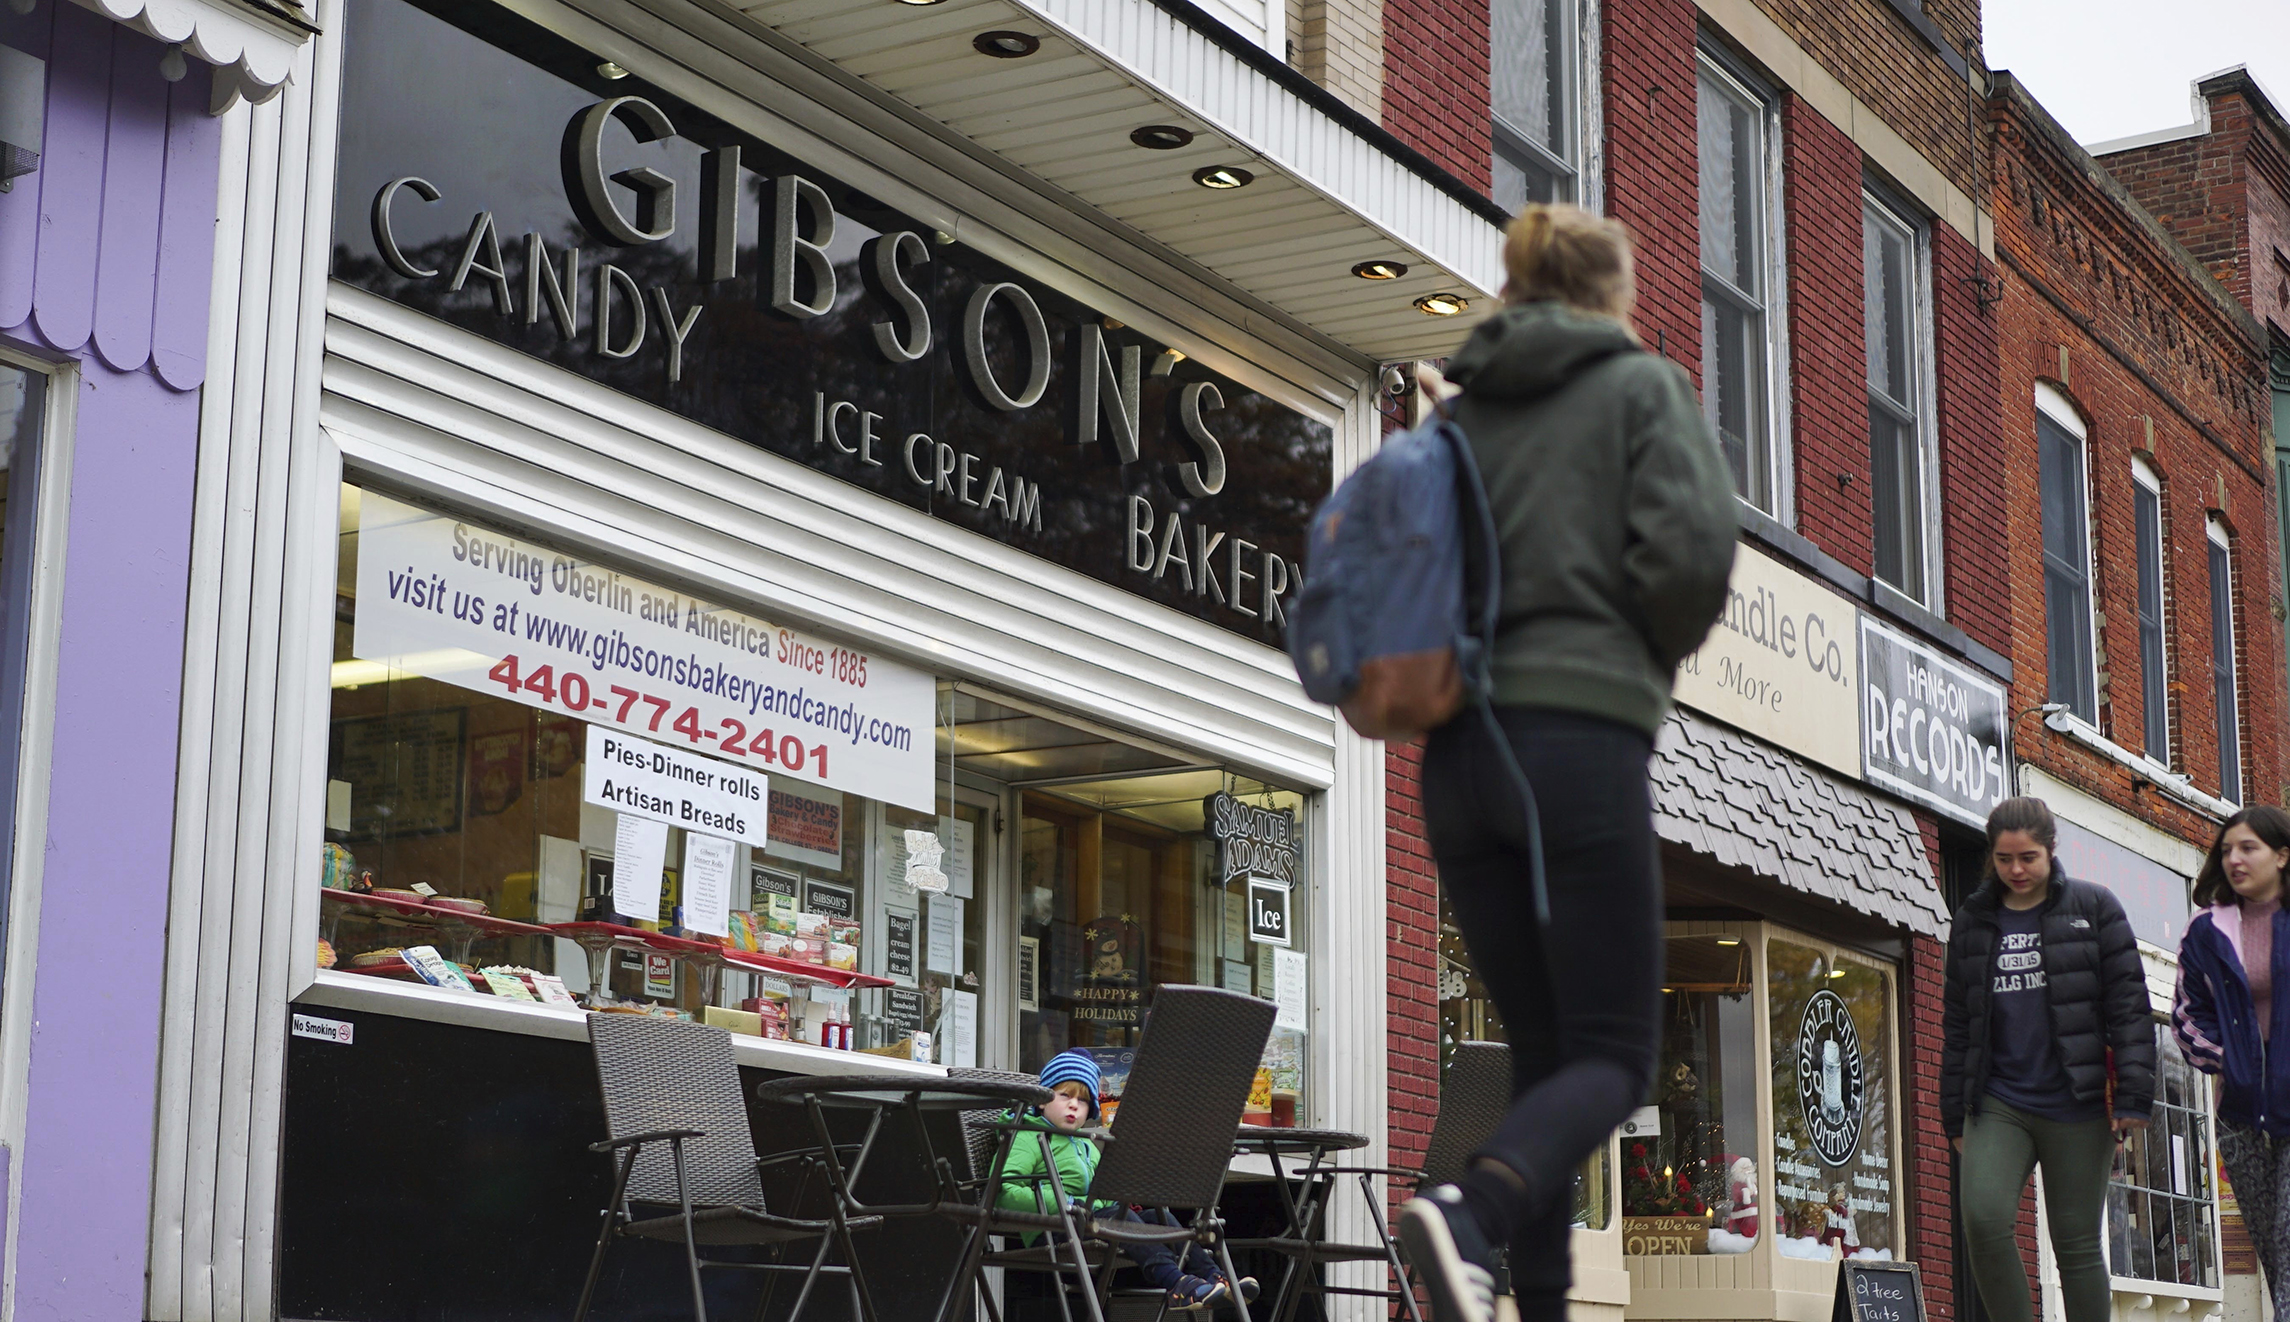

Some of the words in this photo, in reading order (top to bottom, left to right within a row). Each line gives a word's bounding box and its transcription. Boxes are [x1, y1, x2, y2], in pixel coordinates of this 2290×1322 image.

[371, 176, 703, 382] CANDY
[561, 96, 1226, 497] GIBSON'S
[815, 392, 883, 466] ICE
[904, 434, 1042, 532] CREAM
[452, 522, 544, 596] Serving
[552, 555, 632, 614] Oberlin
[640, 589, 679, 630] and
[685, 600, 771, 659] America
[777, 629, 824, 675] Since
[829, 646, 867, 688] 1885
[1716, 585, 1796, 659] ndle
[1805, 612, 1847, 687] Co.
[388, 566, 447, 615] visit
[453, 591, 485, 632] us
[493, 600, 519, 635] at
[526, 613, 911, 752] www.gibsonsbakeryandcandy.com
[1717, 656, 1782, 712] More
[1906, 660, 1969, 724] HANSON
[488, 654, 829, 779] 440-774-2401
[1869, 683, 2001, 807] RECORDS
[602, 739, 715, 788] Pies-Dinner
[719, 774, 761, 801] rolls
[601, 779, 674, 817] Artisan
[681, 799, 746, 835] Breads
[769, 790, 839, 819] GIBSON'S
[769, 803, 799, 822] Bakery
[801, 811, 808, 822] &
[811, 814, 838, 831] Candy
[777, 817, 829, 836] Chocolate
[1215, 794, 1299, 853] SAMUEL
[770, 824, 837, 846] Strawberries
[1224, 836, 1296, 889] ADAMS
[756, 875, 792, 894] Gibson's
[813, 892, 848, 909] GIBSON'S
[890, 918, 911, 931] Bagel
[1257, 899, 1281, 929] Ice
[889, 950, 911, 961] cheese
[890, 940, 910, 949] cream
[650, 966, 670, 975] Card
[653, 956, 667, 966] We
[2001, 953, 2038, 968] 1/31/15
[765, 981, 788, 992] DOLLARS
[1083, 988, 1129, 1000] HAPPY
[892, 1001, 917, 1011] Sandwich
[1075, 1007, 1137, 1021] HOLIDAYS
[293, 1019, 304, 1031] No
[305, 1020, 337, 1039] Smoking
[1809, 1104, 1856, 1156] COMPANY
[1622, 1218, 1649, 1233] Yes
[1655, 1218, 1702, 1231] We're
[1627, 1236, 1693, 1256] OPEN
[1856, 1274, 1869, 1296] 2
[1858, 1303, 1900, 1322] Tarts
